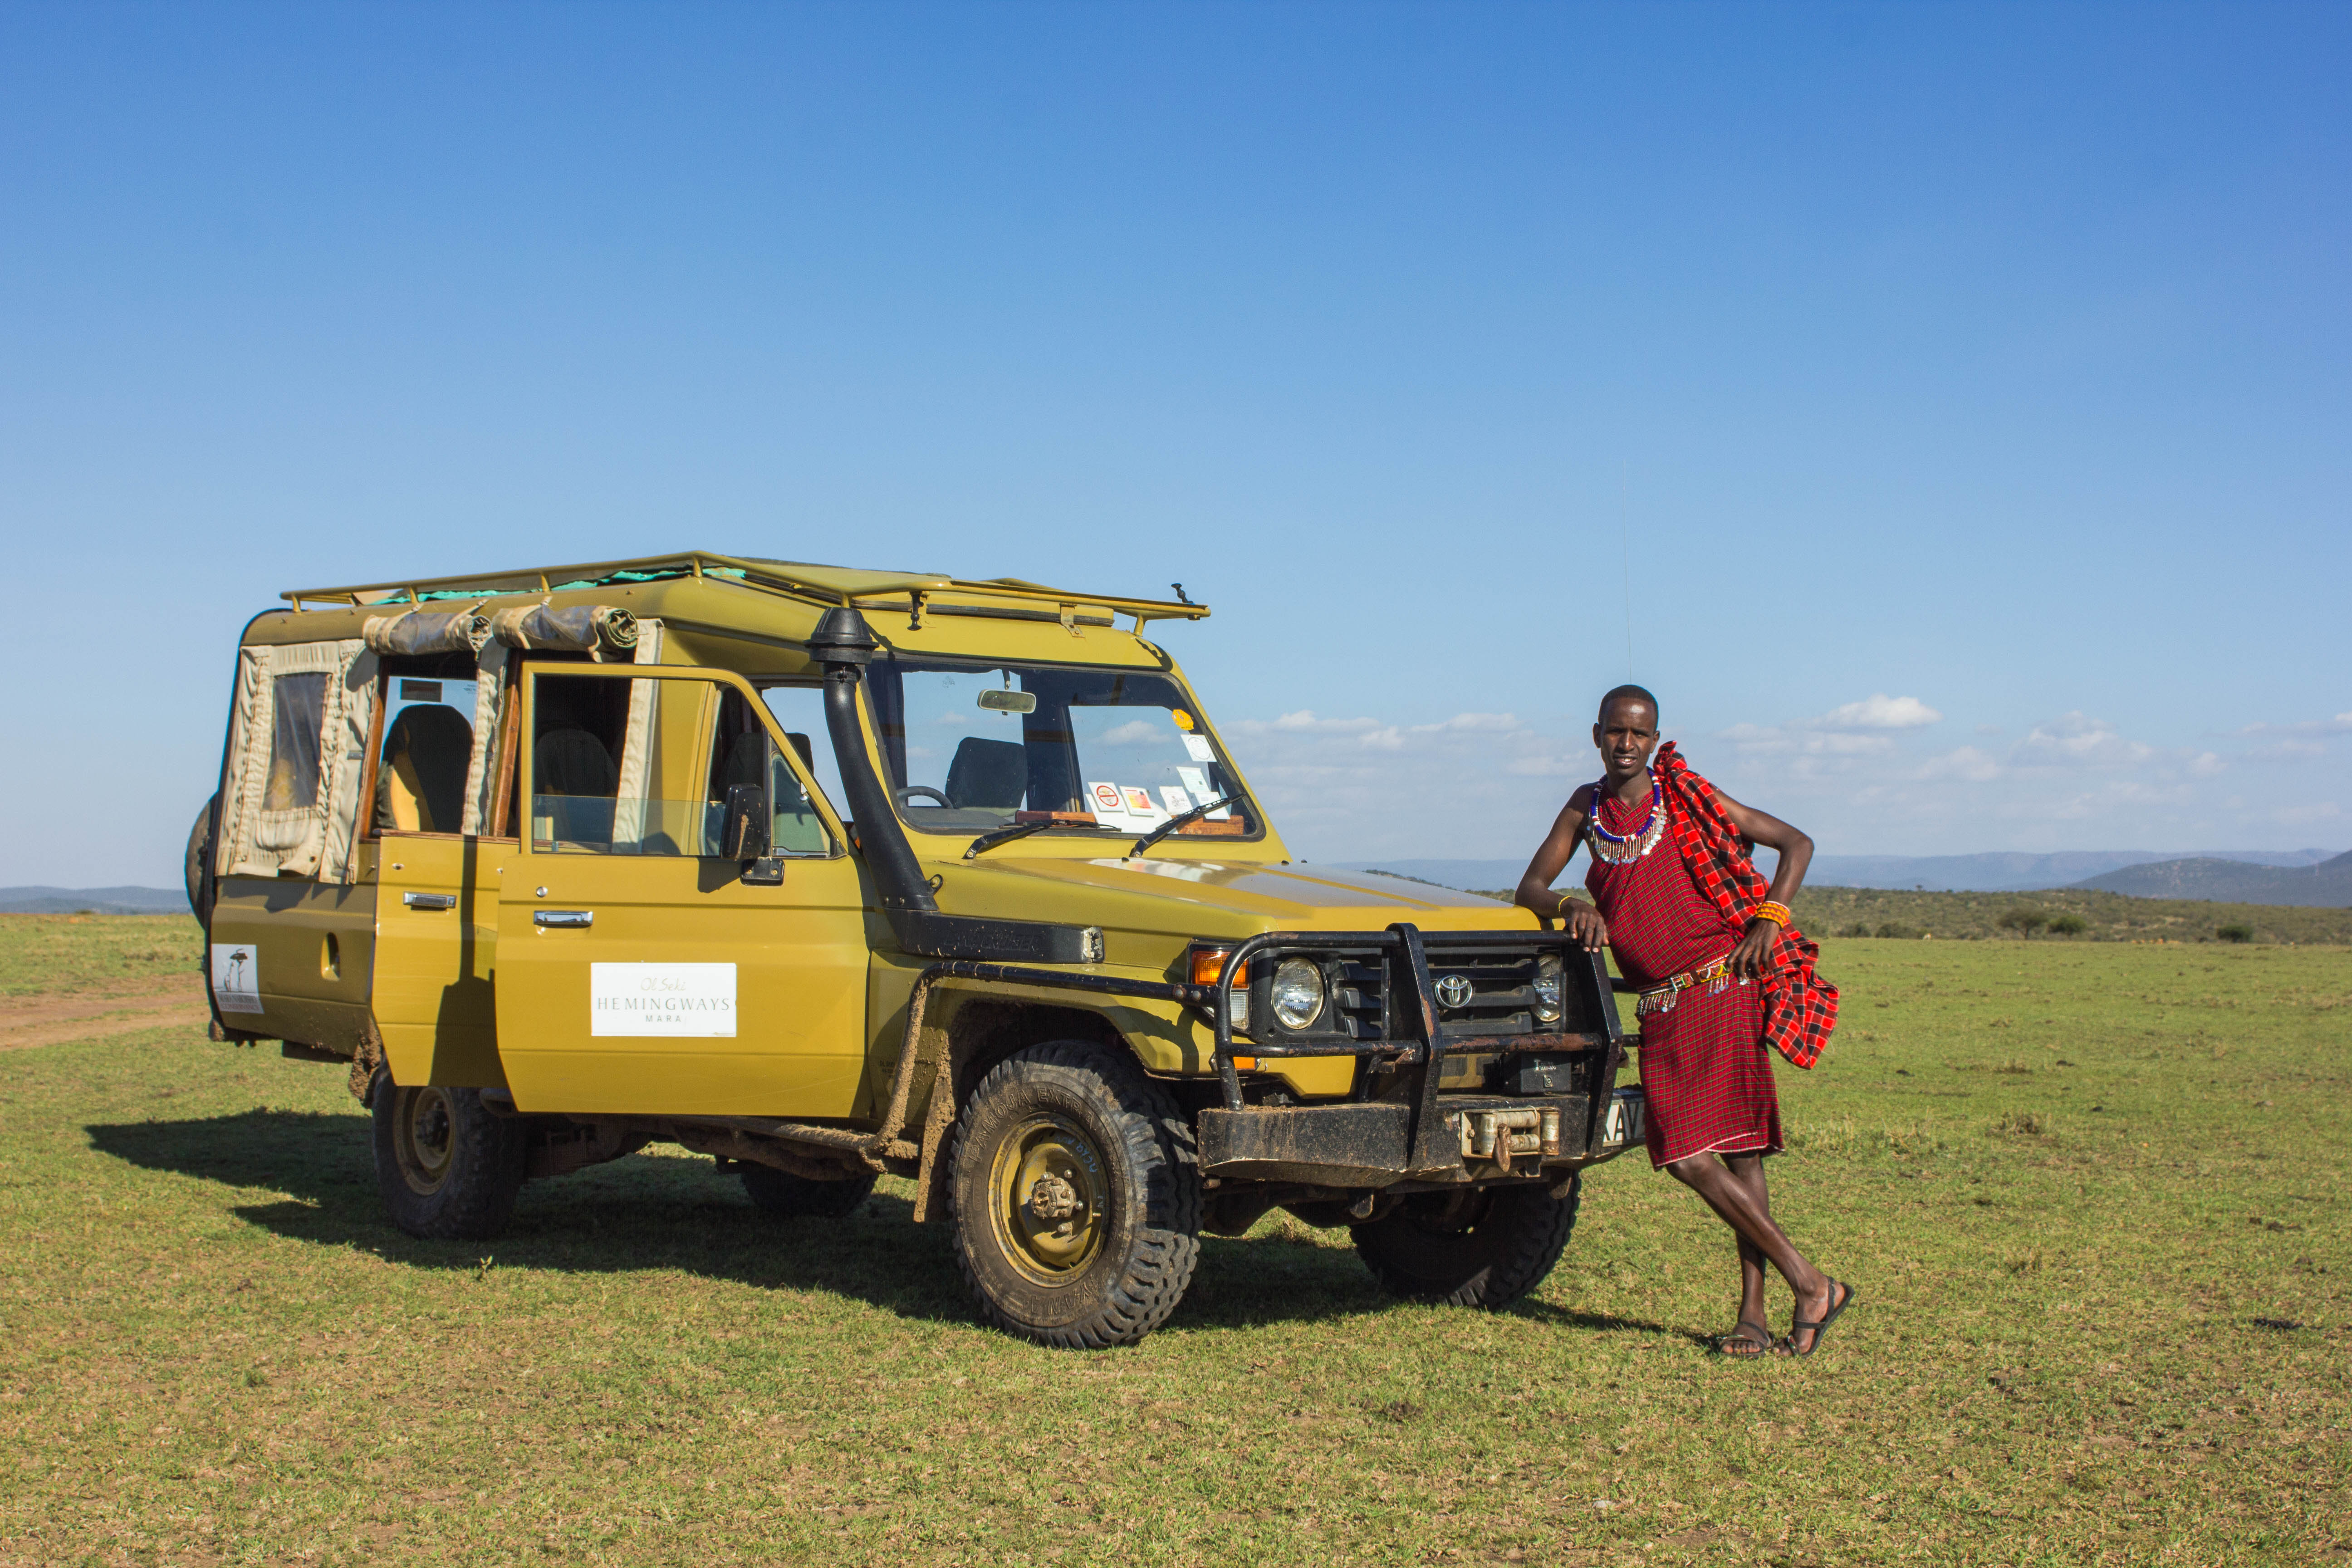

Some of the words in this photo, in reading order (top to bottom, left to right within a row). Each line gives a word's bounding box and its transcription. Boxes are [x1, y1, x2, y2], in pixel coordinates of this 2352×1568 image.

[641, 977, 657, 991] Ol
[659, 978, 686, 991] Seki
[598, 998, 730, 1010] HEMINGWAYS
[969, 1089, 1031, 1163] PAMOJA
[1036, 1086, 1093, 1129] EXTRA
